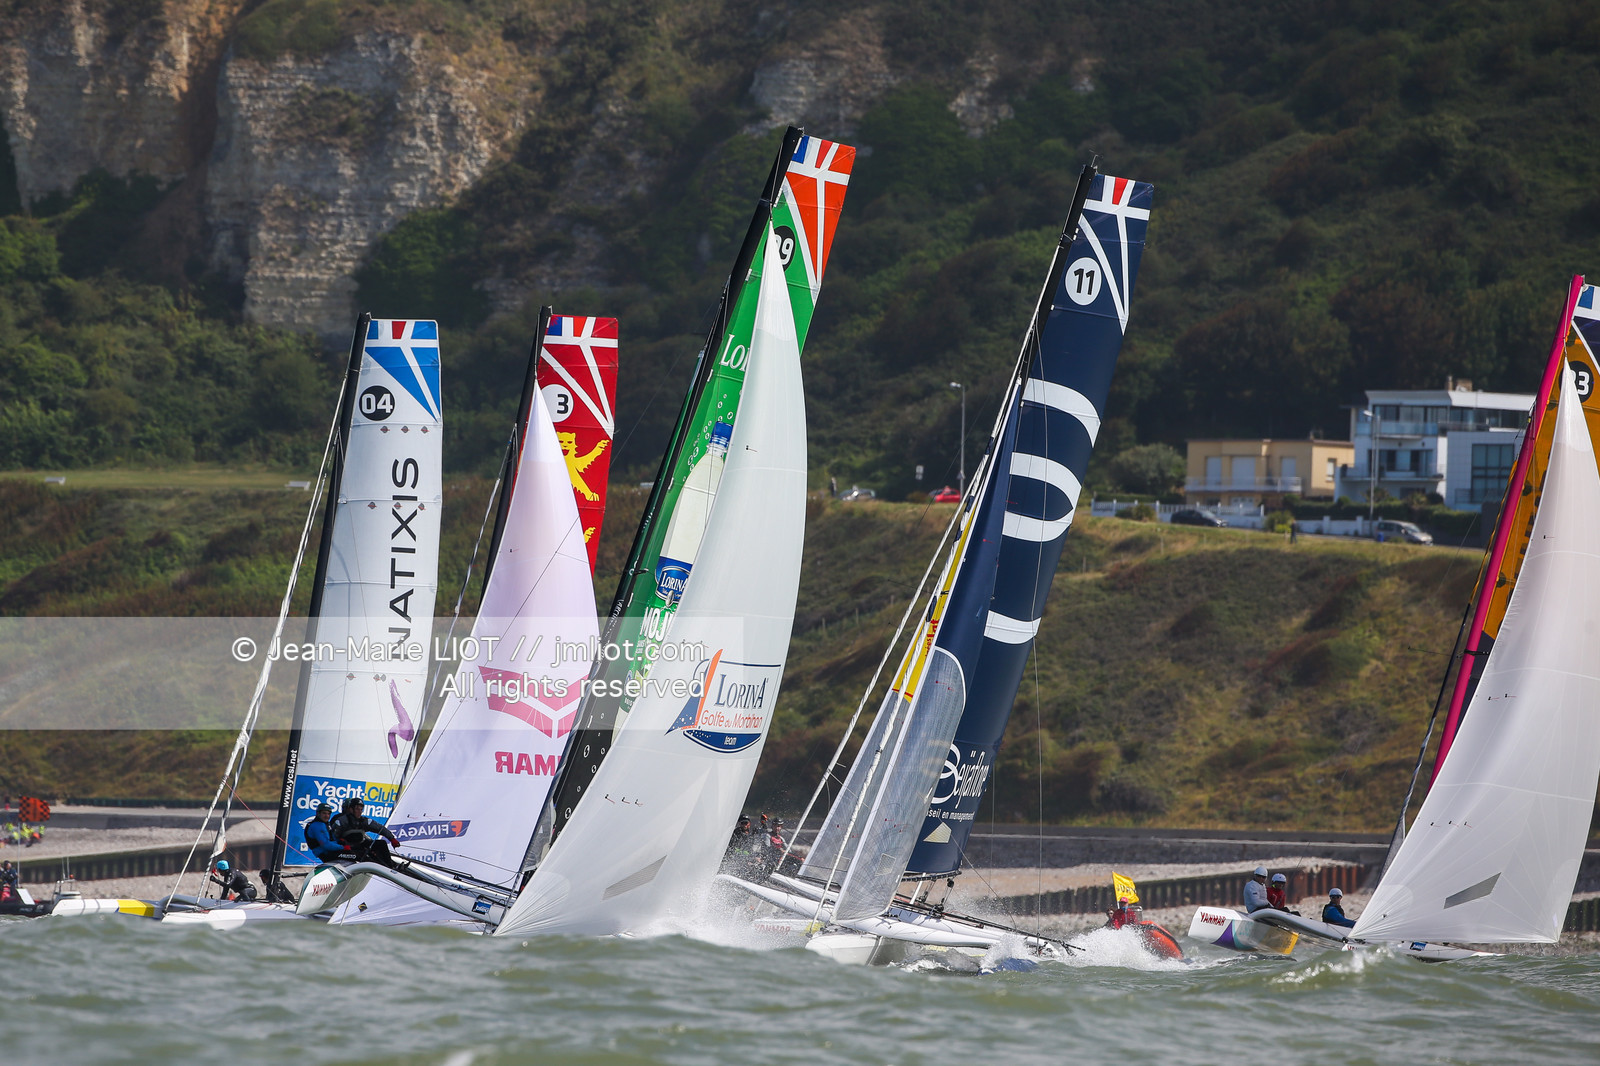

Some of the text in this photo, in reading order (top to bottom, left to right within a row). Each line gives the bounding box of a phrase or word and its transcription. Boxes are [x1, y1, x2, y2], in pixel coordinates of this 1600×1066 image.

[1074, 268, 1095, 295] 11
[362, 393, 393, 413] 04
[388, 457, 419, 660] NATIXIS
[701, 710, 724, 727] Golfe
[297, 794, 321, 810] de
[1200, 912, 1226, 926] YANMAR
